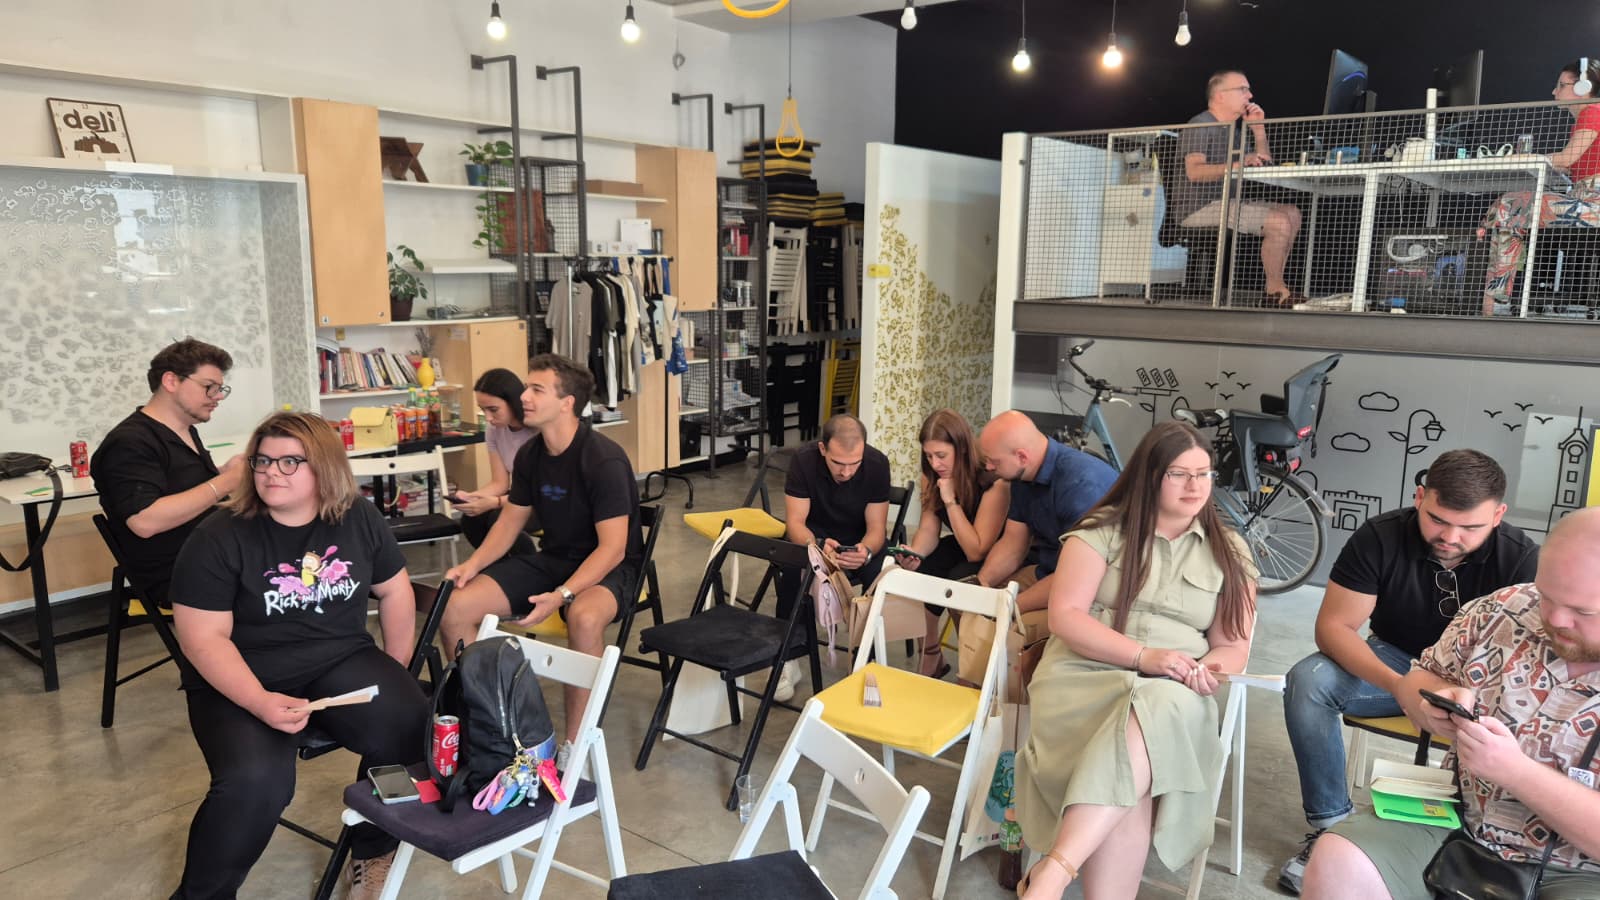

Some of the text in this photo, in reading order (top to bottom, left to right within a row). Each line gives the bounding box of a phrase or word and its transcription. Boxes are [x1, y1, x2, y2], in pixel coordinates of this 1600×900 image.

[63, 109, 116, 132] deli
[263, 590, 300, 616] Rick
[316, 577, 361, 602] Morty
